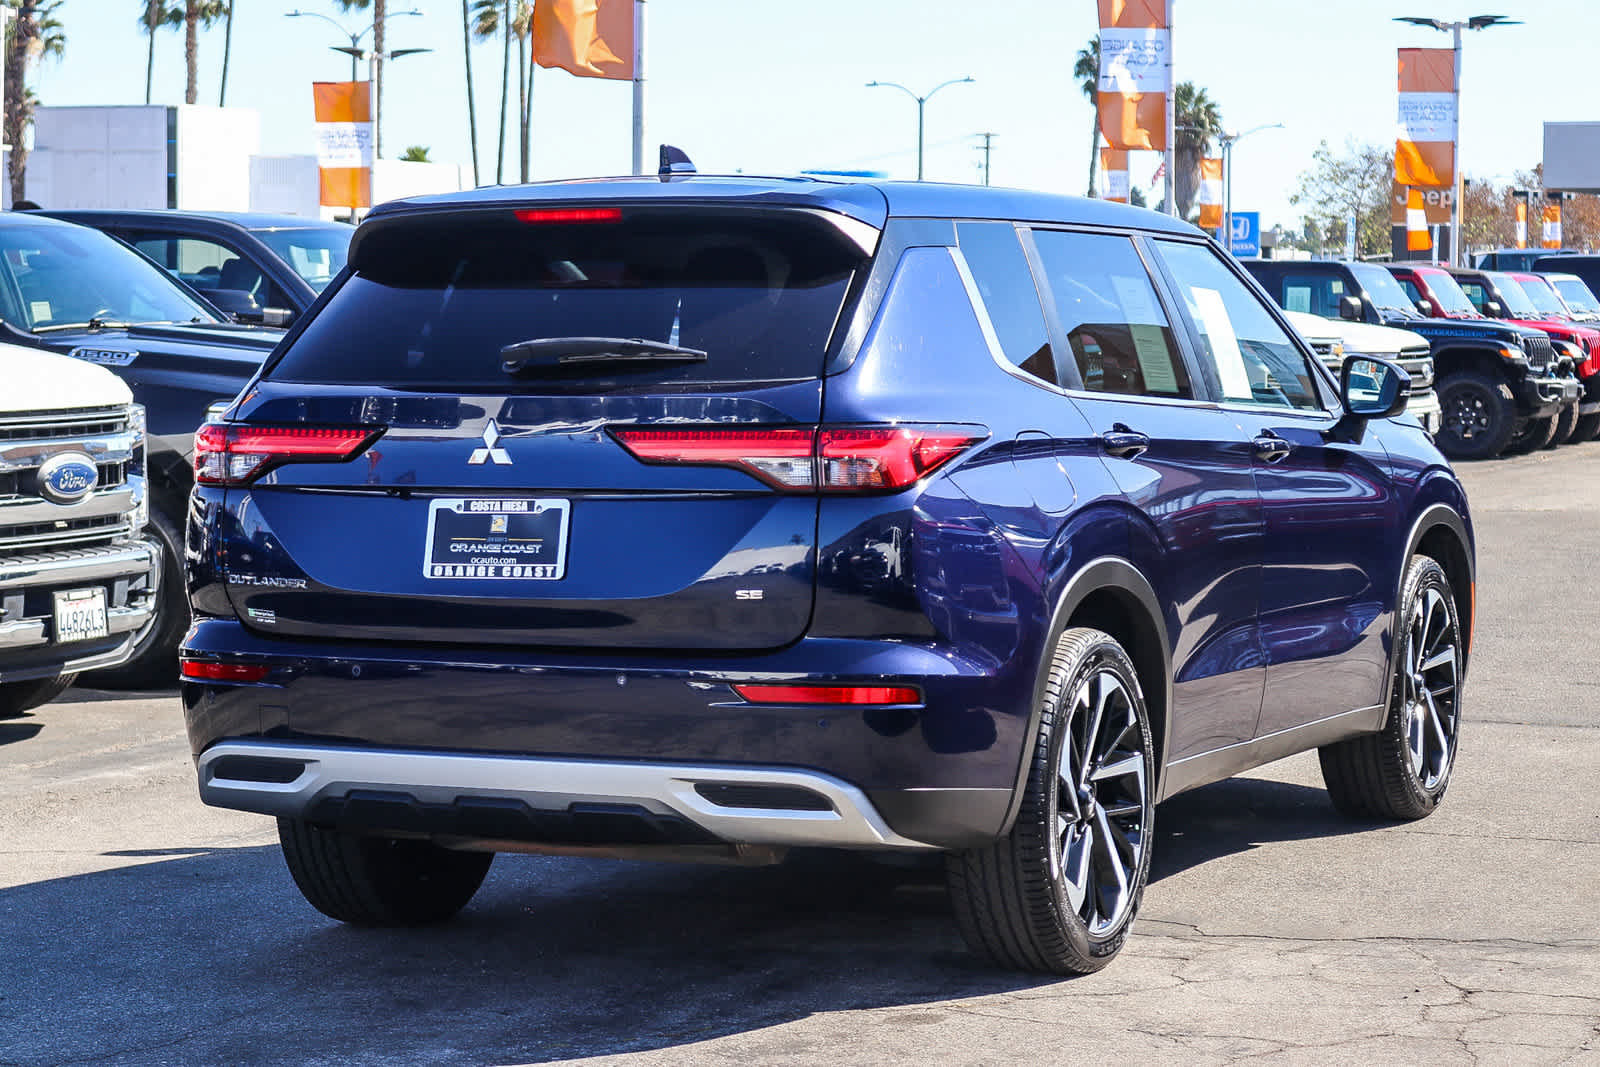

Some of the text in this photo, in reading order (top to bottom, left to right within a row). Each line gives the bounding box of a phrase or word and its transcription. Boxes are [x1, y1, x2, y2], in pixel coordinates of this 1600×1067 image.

[1396, 185, 1453, 208] Jep
[80, 349, 127, 360] 1500
[58, 468, 88, 489] Ford
[470, 500, 528, 512] COSTA MESA
[450, 543, 542, 554] ORANGE COAST
[470, 556, 517, 565] ocauto.com
[433, 565, 554, 578] ORANGE COAST
[228, 574, 308, 589] OUTLANDER
[735, 589, 763, 600] SE
[60, 608, 105, 632] 44826L3
